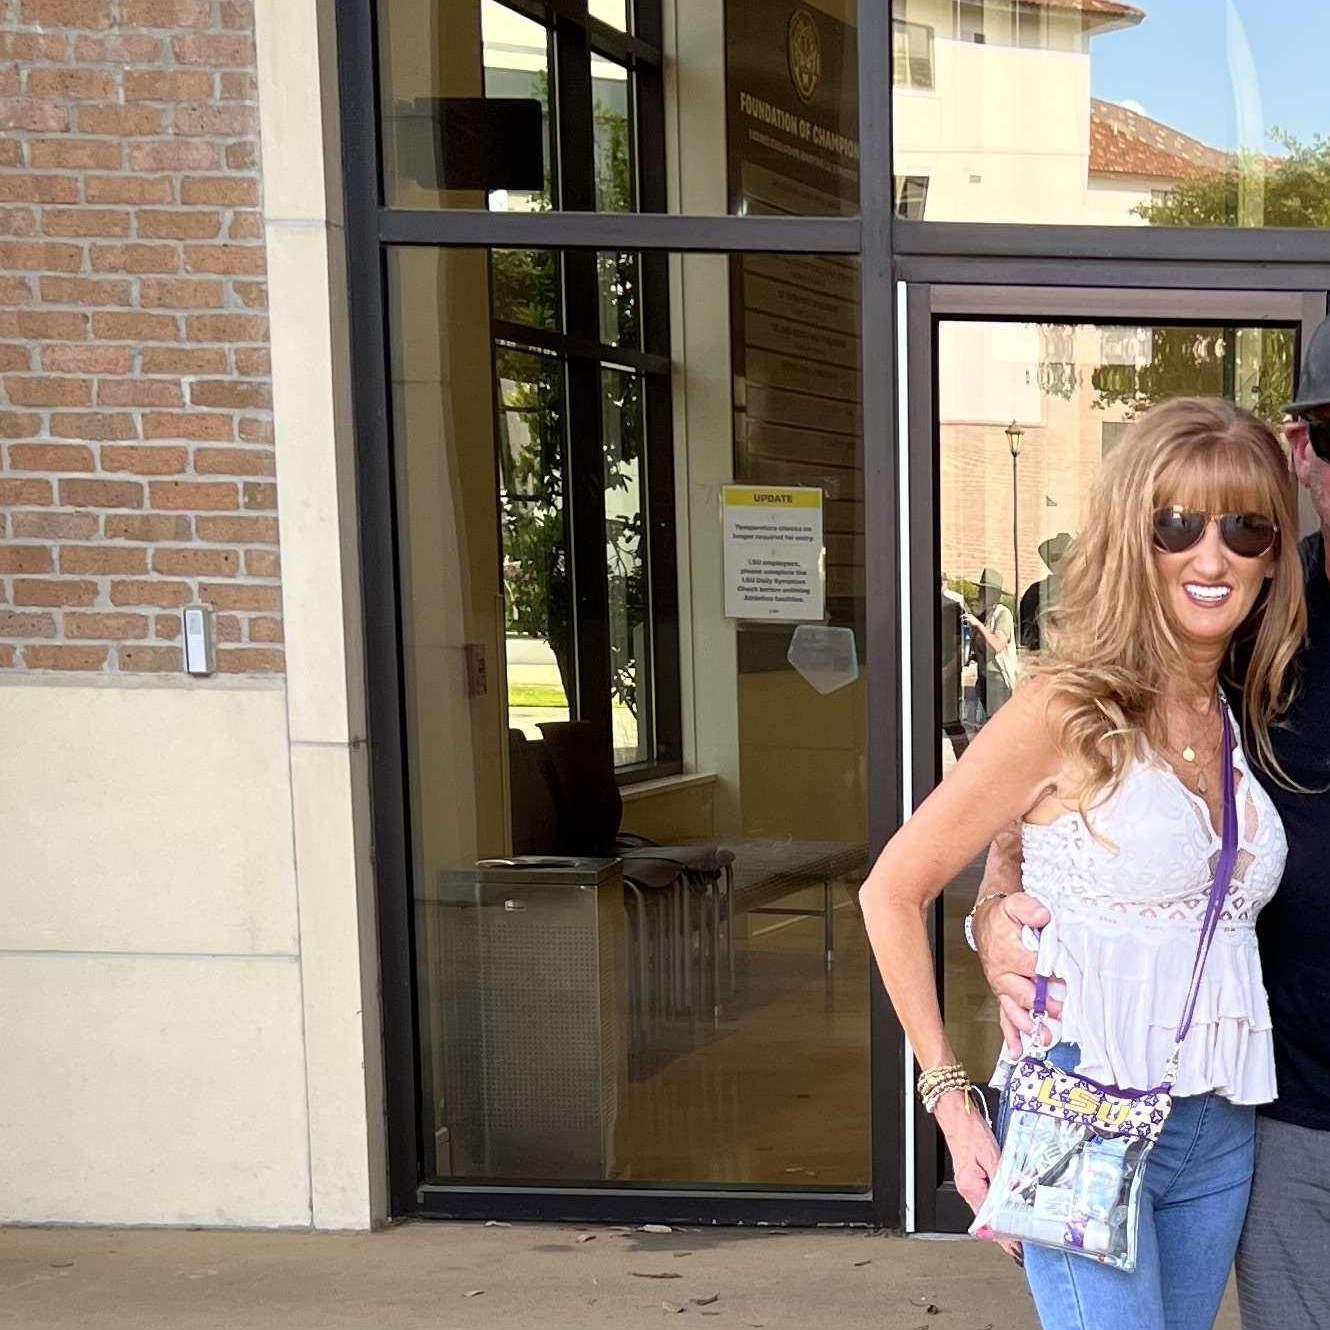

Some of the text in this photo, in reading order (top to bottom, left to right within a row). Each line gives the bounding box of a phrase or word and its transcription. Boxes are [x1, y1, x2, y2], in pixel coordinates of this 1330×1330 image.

[740, 91, 798, 136] FOUNDATION
[800, 118, 811, 141] OF
[753, 494, 793, 503] UPDATE
[1038, 1078, 1131, 1126] LSU
